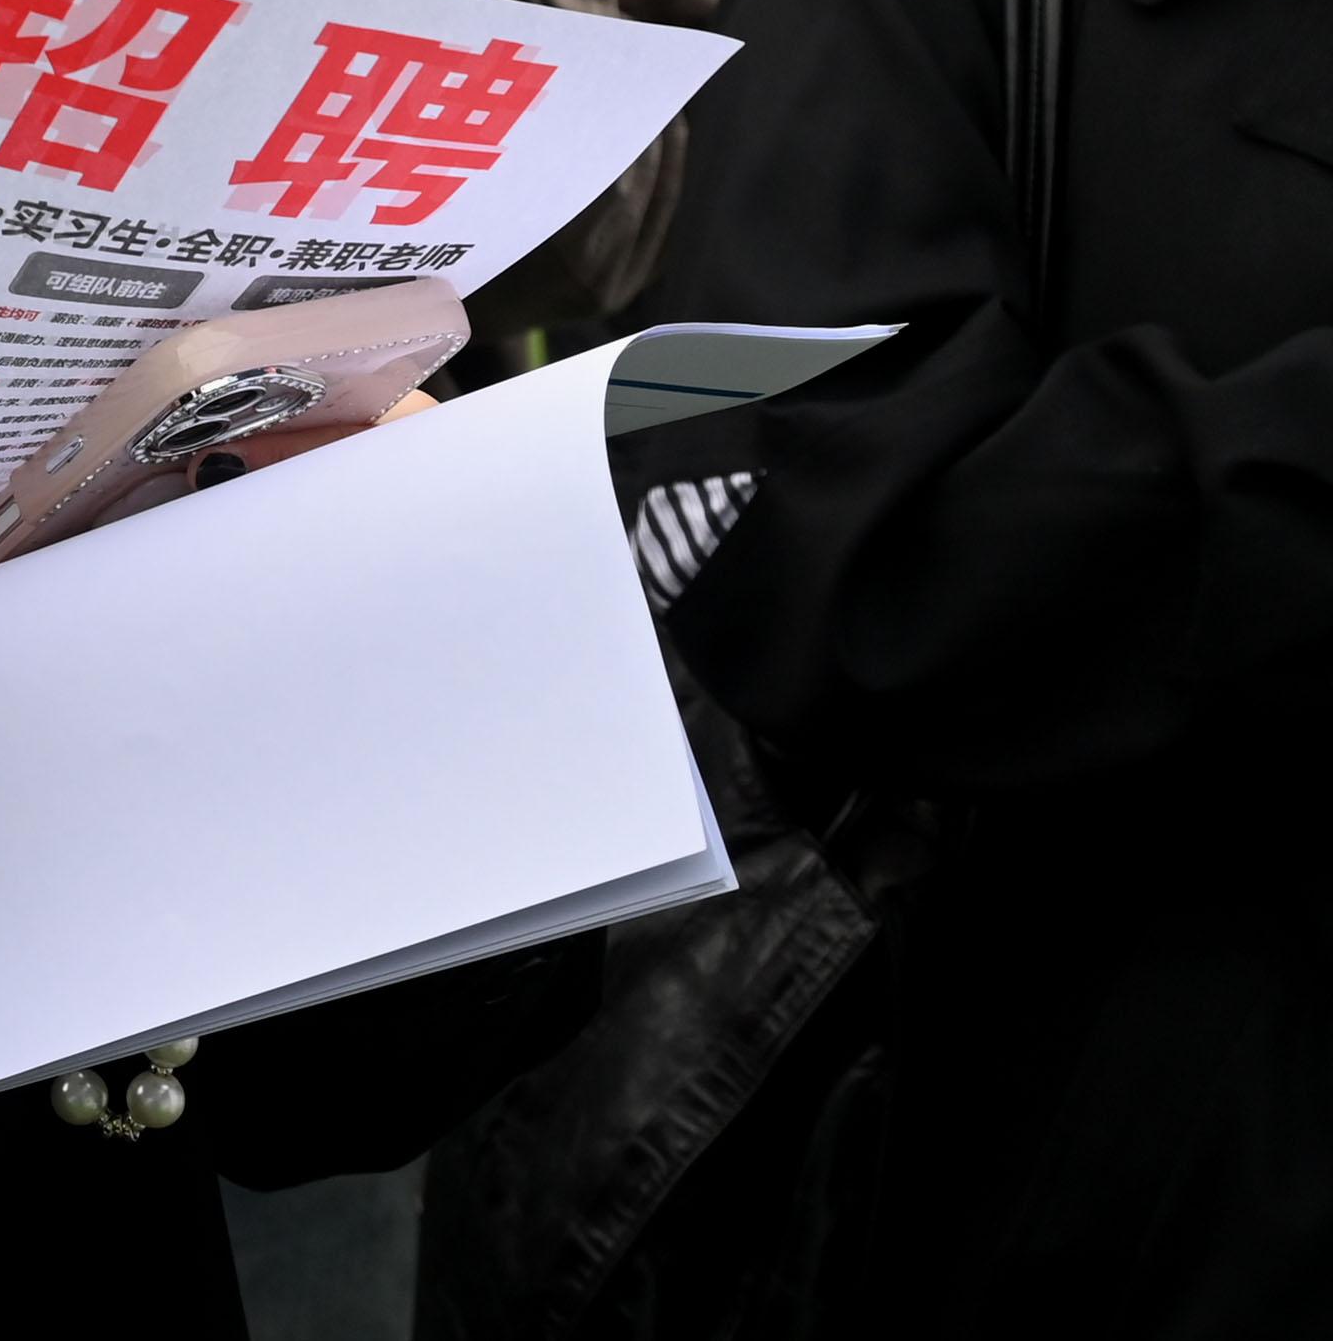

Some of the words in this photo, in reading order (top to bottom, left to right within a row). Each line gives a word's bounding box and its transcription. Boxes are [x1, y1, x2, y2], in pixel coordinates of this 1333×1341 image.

[46, 270, 167, 300] 可组队前往
